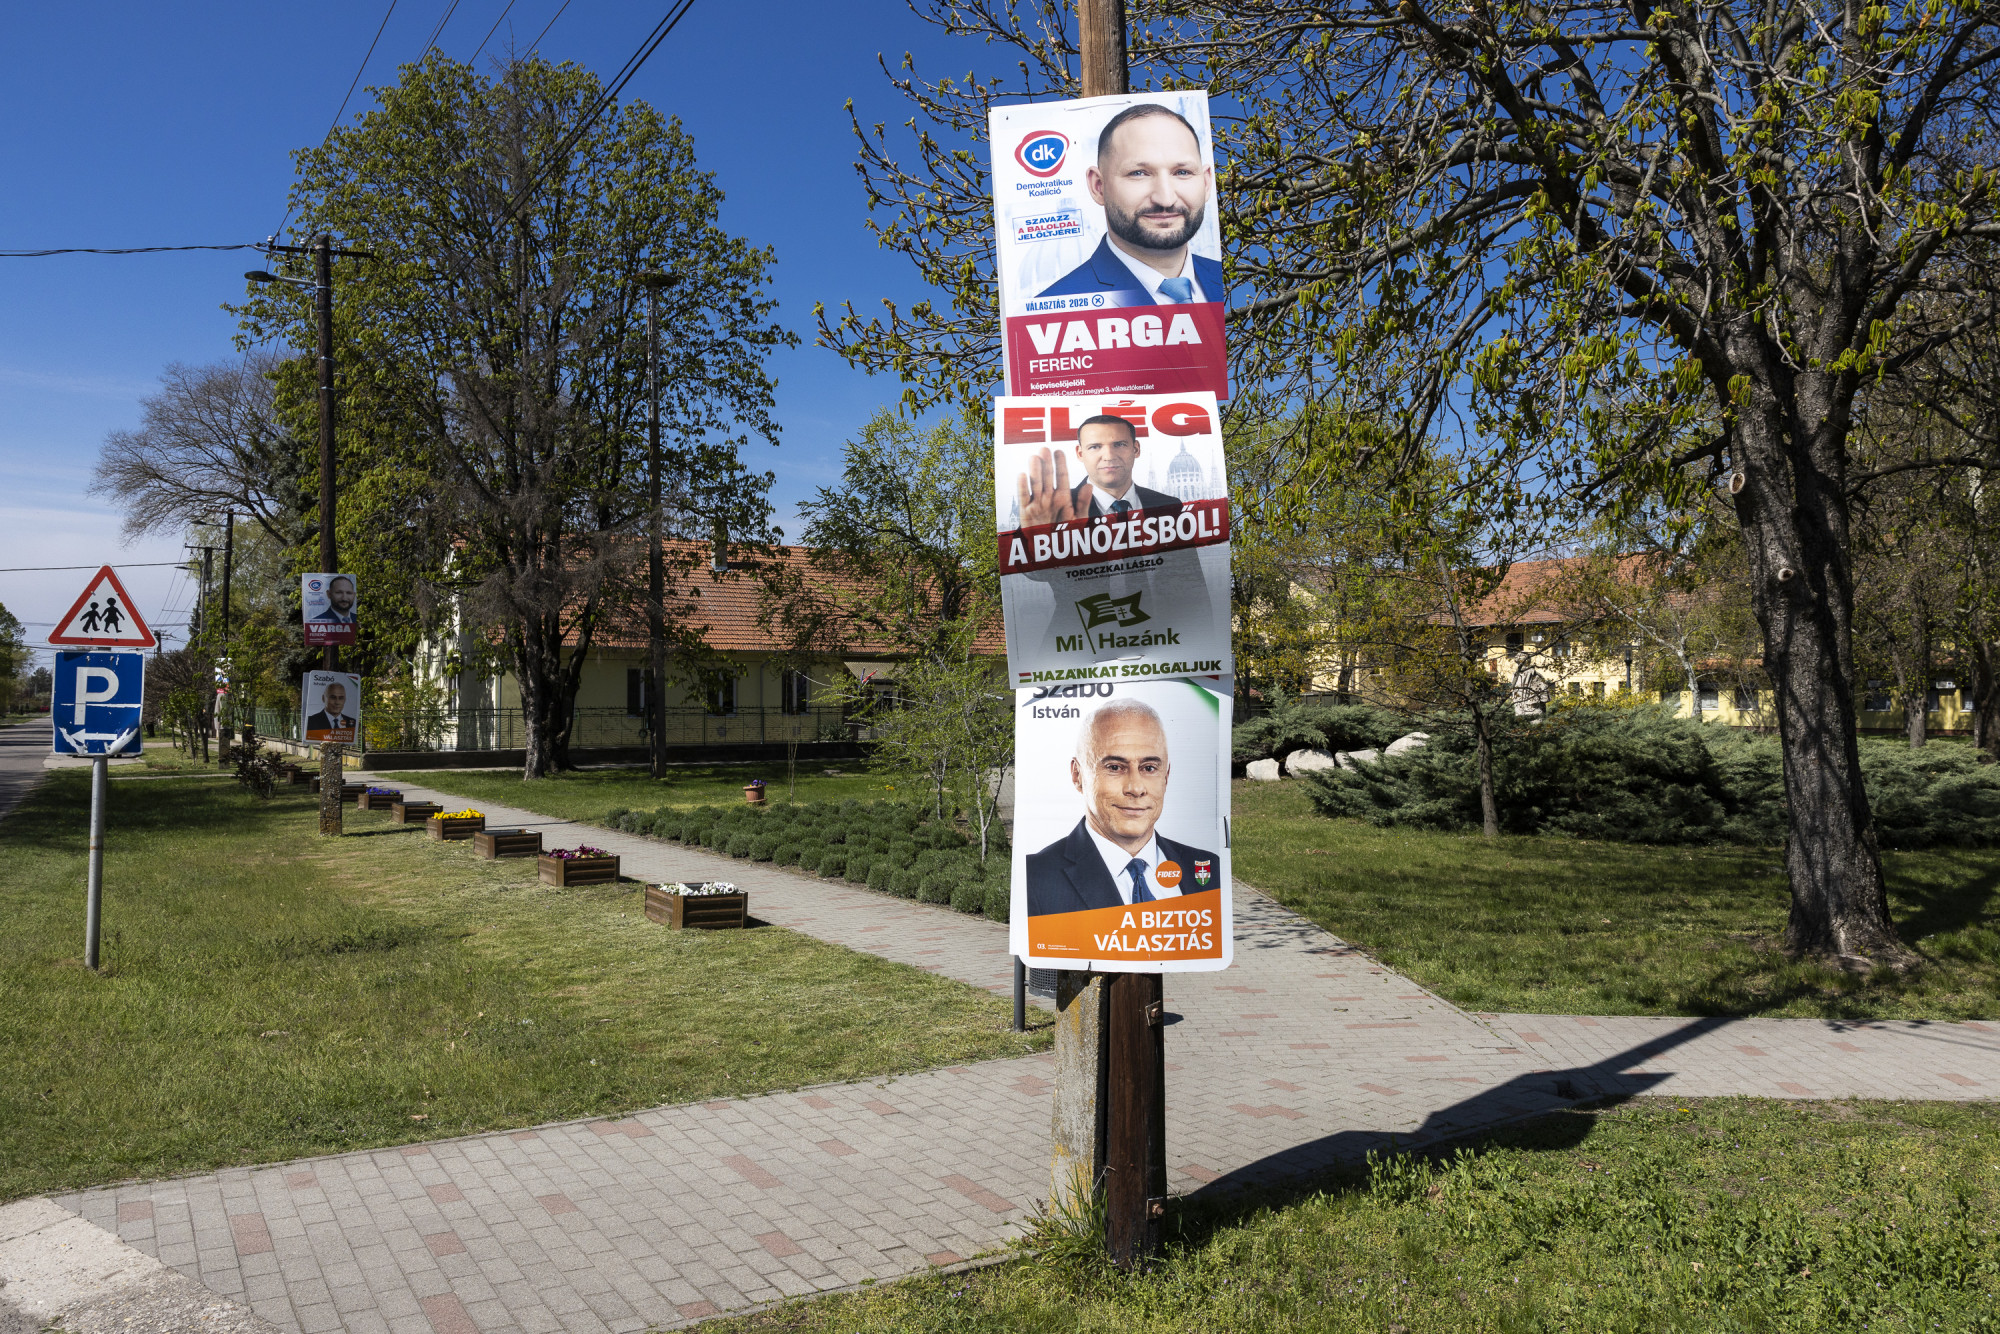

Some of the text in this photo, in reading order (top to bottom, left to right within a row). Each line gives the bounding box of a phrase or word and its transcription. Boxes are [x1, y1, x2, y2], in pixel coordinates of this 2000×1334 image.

[1031, 144, 1057, 162] dk
[1016, 179, 1073, 191] Demokratikus
[1028, 187, 1062, 197] Koalíció
[1025, 214, 1070, 226] SZAVAZZ
[1027, 220, 1079, 233] BALOLDAL
[1025, 298, 1089, 312] VÁLASZTÁS 2026
[1025, 313, 1203, 355] VARGA
[1029, 355, 1094, 373] FERENC
[1030, 378, 1086, 391] képviselőjelölt
[1085, 388, 1105, 396] megye
[1111, 384, 1155, 392] választókerület
[1003, 399, 1213, 445] ELÉG
[1007, 504, 1221, 567] A BŰNÖZÉSBŐL!
[1065, 563, 1124, 578] TOROCZKAI
[1126, 556, 1164, 570] LÁSZLÓ
[309, 624, 351, 633] VARGA
[1055, 628, 1181, 653] Mi Hazánk
[313, 674, 335, 682] Szabó
[1032, 659, 1222, 683] HAZÁNKAT SZOLGÁLJUK
[74, 666, 119, 725] P
[1032, 704, 1080, 719] István
[1157, 870, 1181, 878] FIDESZ
[1120, 909, 1213, 929] A BIZTOS
[1093, 929, 1213, 952] VÁLASZTÁS
